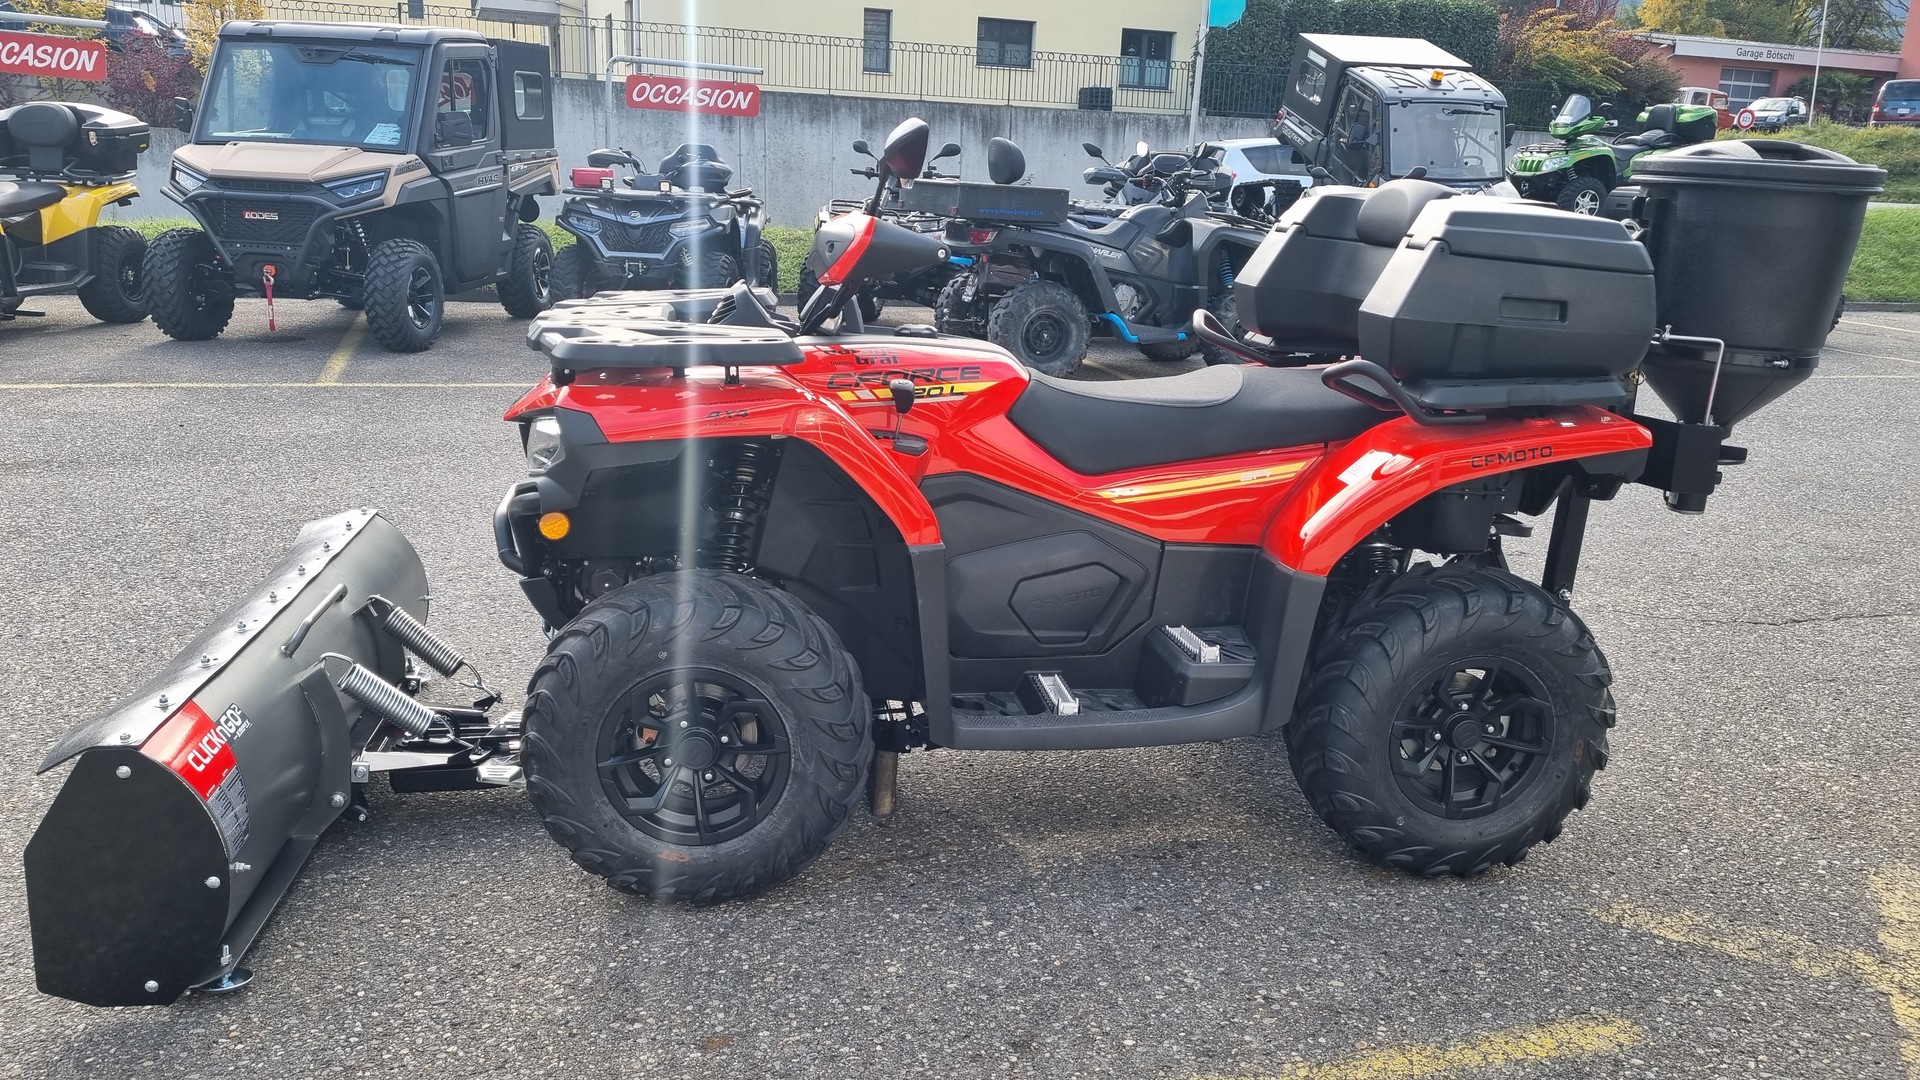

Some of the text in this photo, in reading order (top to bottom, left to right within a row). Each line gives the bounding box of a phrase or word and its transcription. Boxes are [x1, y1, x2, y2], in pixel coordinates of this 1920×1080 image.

[0, 41, 99, 72] CASION
[1736, 47, 1796, 61] Garage Bötschi
[632, 82, 753, 110] OCCASION
[826, 365, 981, 390] CFORCE
[914, 386, 944, 398] 20
[1471, 446, 1553, 468] CFMOTO
